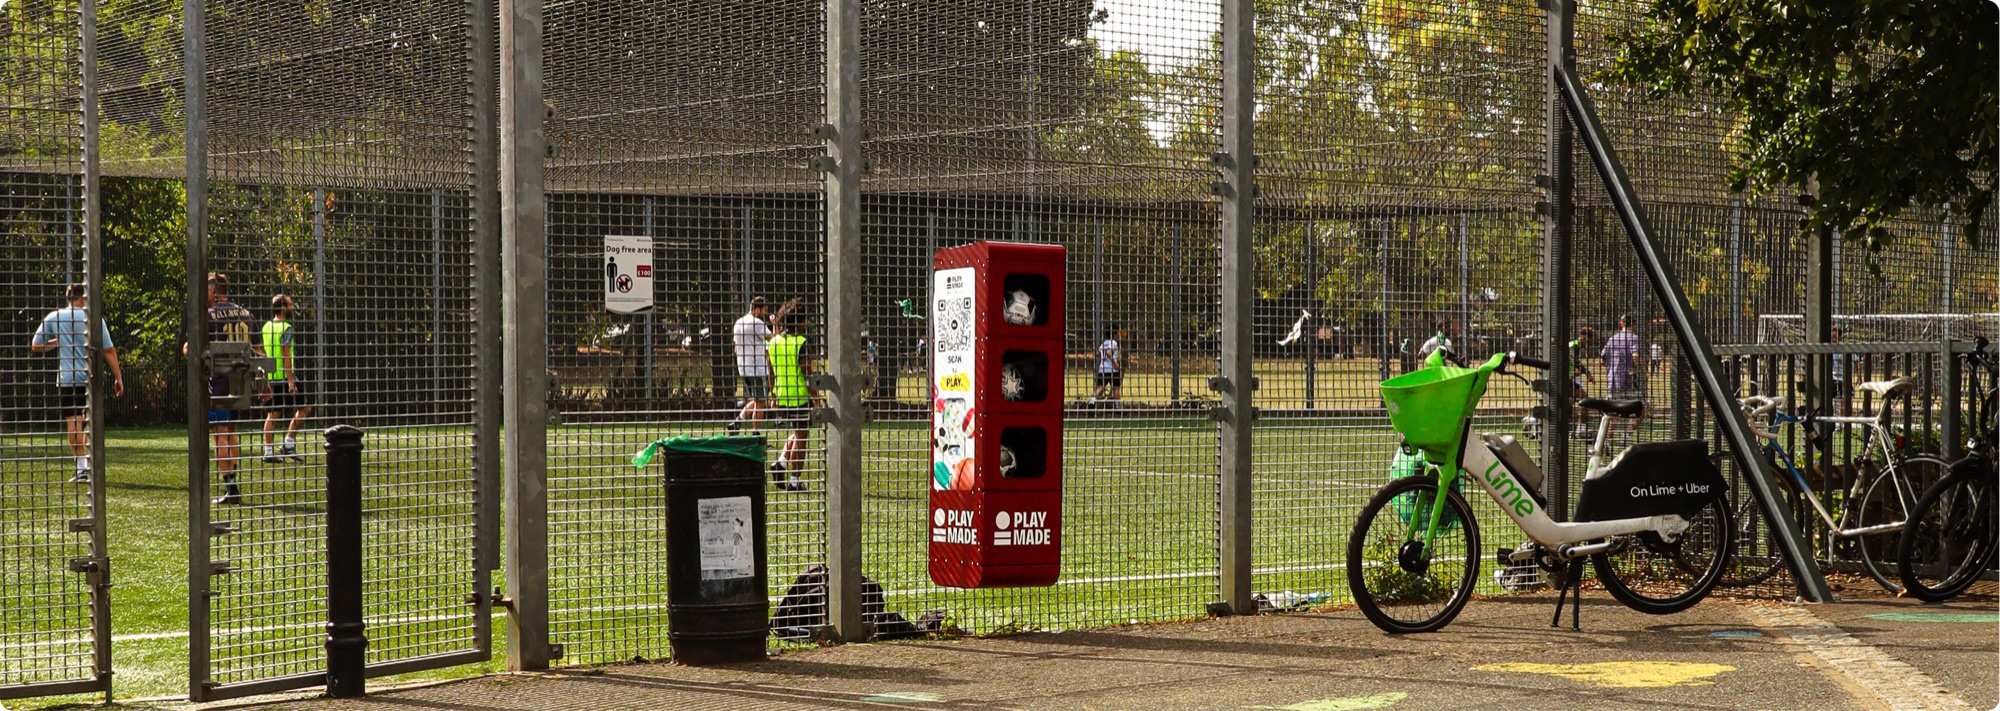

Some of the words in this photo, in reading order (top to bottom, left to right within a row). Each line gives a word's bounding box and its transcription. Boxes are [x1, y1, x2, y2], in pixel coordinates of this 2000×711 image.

[606, 245, 620, 254] Dog
[621, 245, 636, 253] free
[223, 320, 249, 342] 10
[1630, 486, 1648, 498] On
[1649, 484, 1676, 496] Lime
[1685, 482, 1710, 494] Uber
[948, 509, 974, 527] PLAY
[1014, 511, 1047, 528] PLAY
[947, 527, 977, 545] MADE
[1013, 529, 1051, 546] MADE
